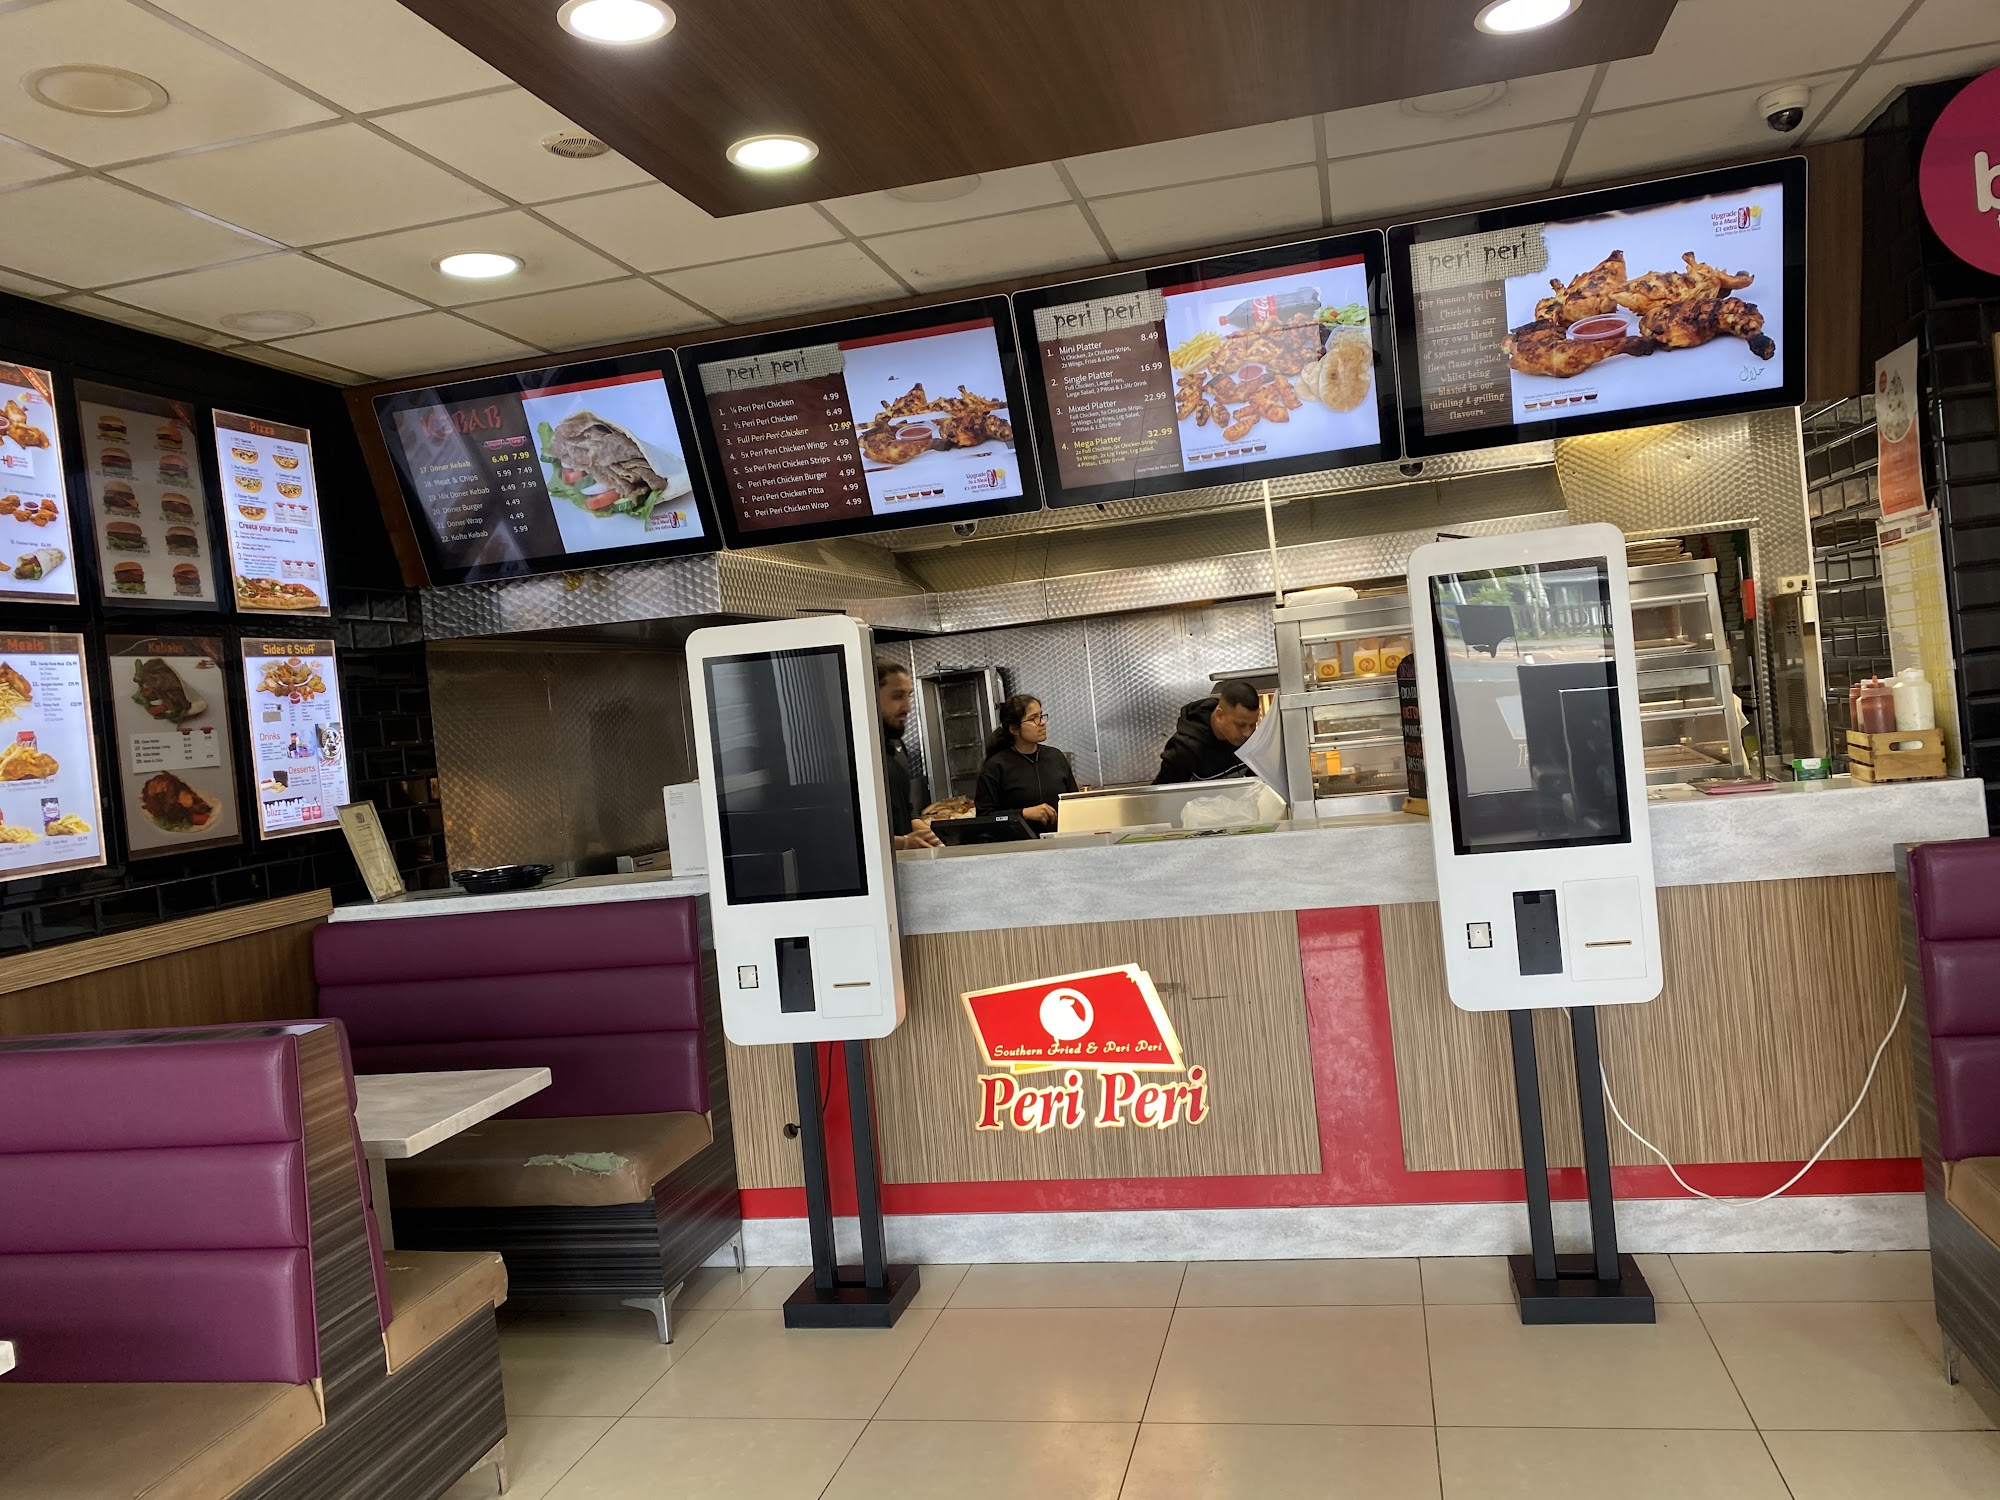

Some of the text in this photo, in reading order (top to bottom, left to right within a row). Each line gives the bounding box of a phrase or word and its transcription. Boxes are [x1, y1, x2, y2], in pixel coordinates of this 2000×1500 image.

[1711, 210, 1737, 220] Upgrade
[1428, 233, 1527, 283] peri peri
[1418, 288, 1502, 311] Our famous Peri-Peri
[1054, 295, 1142, 340] peri peri
[1440, 305, 1481, 320] Chicken is
[1427, 320, 1469, 334] marinated
[1471, 318, 1480, 326] in
[1059, 345, 1075, 354] Mini
[1077, 342, 1102, 352] Platter
[1140, 331, 1159, 341] 8.49
[1432, 329, 1493, 346] very own blend
[1095, 348, 1114, 358] Chicken
[1106, 354, 1120, 362] Drink
[1424, 352, 1431, 360] of
[1434, 349, 1458, 359] spices
[1461, 346, 1476, 354] and
[726, 351, 809, 391] peri peri
[1428, 354, 1501, 372] then flame grilled
[1064, 374, 1087, 385] Single
[1088, 370, 1114, 381] Platter
[1140, 362, 1163, 372] 16.99
[1441, 369, 1491, 383] whilst being
[1438, 386, 1467, 396] blasted
[1480, 382, 1494, 391] our
[752, 403, 766, 411] Peri
[767, 398, 795, 409] Chicken
[823, 392, 839, 401] 4.99
[1068, 403, 1090, 414] Mixed
[1092, 400, 1117, 410] Platter
[1144, 391, 1167, 402] 22.99
[1430, 398, 1463, 410] thrilling
[1474, 392, 1505, 404] grilling
[1450, 409, 1486, 420] flavours.
[249, 421, 275, 434] Pizza
[1074, 439, 1095, 449] Mega
[1096, 435, 1122, 445] Platter
[1147, 428, 1173, 438] 32.99
[764, 447, 778, 456] Peri
[779, 443, 806, 454] Chicken
[806, 440, 827, 450] Wings
[833, 438, 849, 447] 4.99
[450, 460, 471, 469] Kebab
[492, 454, 508, 463] 6.49
[512, 451, 530, 460] 7.99
[768, 463, 781, 471] Peri
[782, 459, 809, 469] Chicken
[810, 456, 830, 465] Strips
[836, 454, 852, 462] 4.99
[434, 478, 450, 486] Meat
[459, 474, 478, 483] Chips
[748, 480, 762, 488] Peri
[762, 478, 776, 486] Peri
[777, 474, 804, 485] Chicken
[805, 472, 827, 482] Burger
[839, 468, 855, 477] 4.99
[450, 489, 469, 498] Doner
[470, 487, 490, 495] Kebab
[501, 484, 516, 492] 6.49
[443, 506, 461, 514] Doner
[462, 503, 483, 512] Burger
[755, 509, 769, 517] Peri
[770, 507, 783, 515] Peri
[784, 503, 811, 513] Chicken
[811, 501, 829, 510] Wrap
[846, 498, 862, 506] 4.99
[259, 524, 271, 533] your
[447, 518, 466, 527] Doner
[466, 517, 483, 526] Wrap
[451, 532, 468, 541] Kofte
[468, 530, 488, 539] Kebab
[513, 525, 528, 533] 5.99
[7, 639, 44, 651] Meals
[148, 642, 185, 654] Kebabs
[263, 644, 315, 654] Sides & Stuff
[288, 766, 315, 774] Desserts
[994, 1039, 1162, 1057] Southern Fried & Peri Peri
[977, 1065, 1208, 1131] Peri Peri
